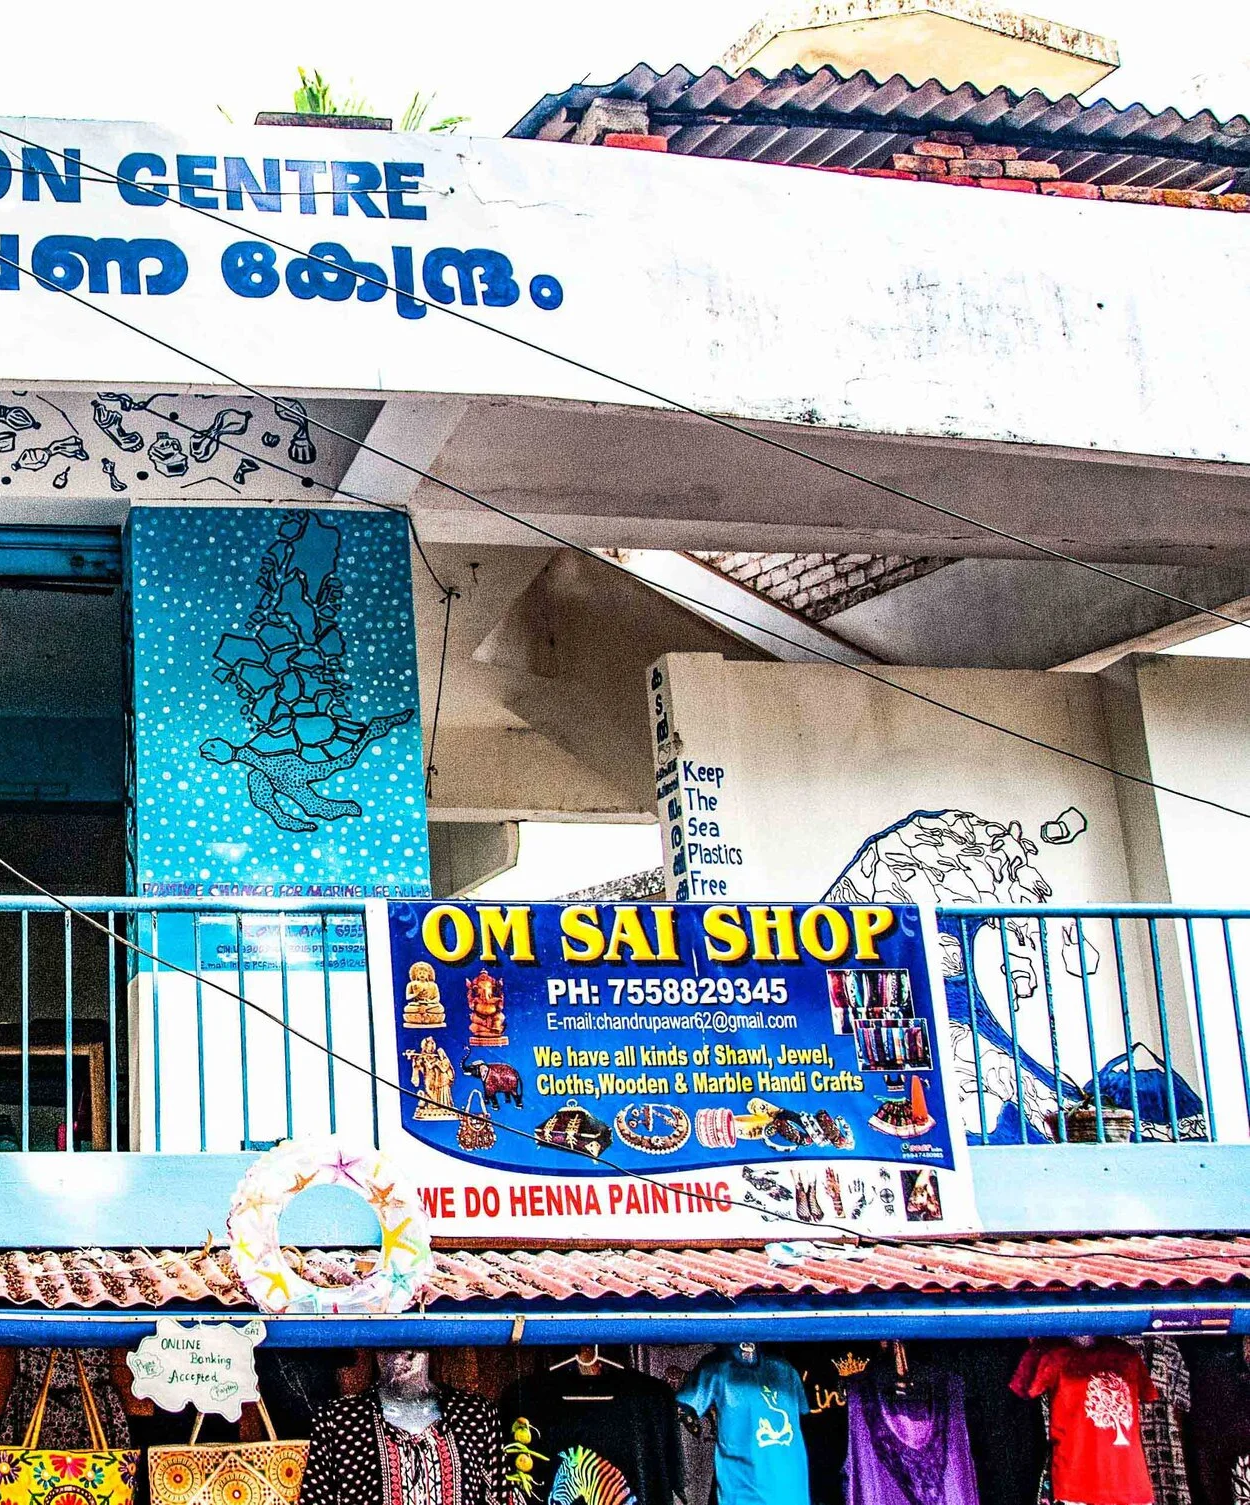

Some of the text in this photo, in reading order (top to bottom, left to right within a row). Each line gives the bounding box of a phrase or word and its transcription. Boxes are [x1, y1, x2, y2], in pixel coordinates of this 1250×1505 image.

[117, 152, 427, 220] CENTRE
[682, 760, 725, 789] Keep
[683, 788, 718, 811] The
[688, 817, 720, 838] Sea
[688, 843, 743, 865] Plastics
[279, 884, 303, 898] FOR
[691, 870, 728, 896] Free
[421, 904, 895, 963] OM SAI SHOP
[547, 977, 788, 1006] PH: 7558829345
[533, 1043, 834, 1069] We have all kinds of Shawl, Jewel,
[674, 1075, 688, 1094] &
[694, 1072, 753, 1094] Marble
[759, 1070, 806, 1093] Handi
[810, 1071, 864, 1092] Crafts
[417, 1181, 733, 1219] WE DO HENNA PAINTING
[161, 1338, 202, 1351] ONLINE
[167, 1369, 218, 1385] Accepted
